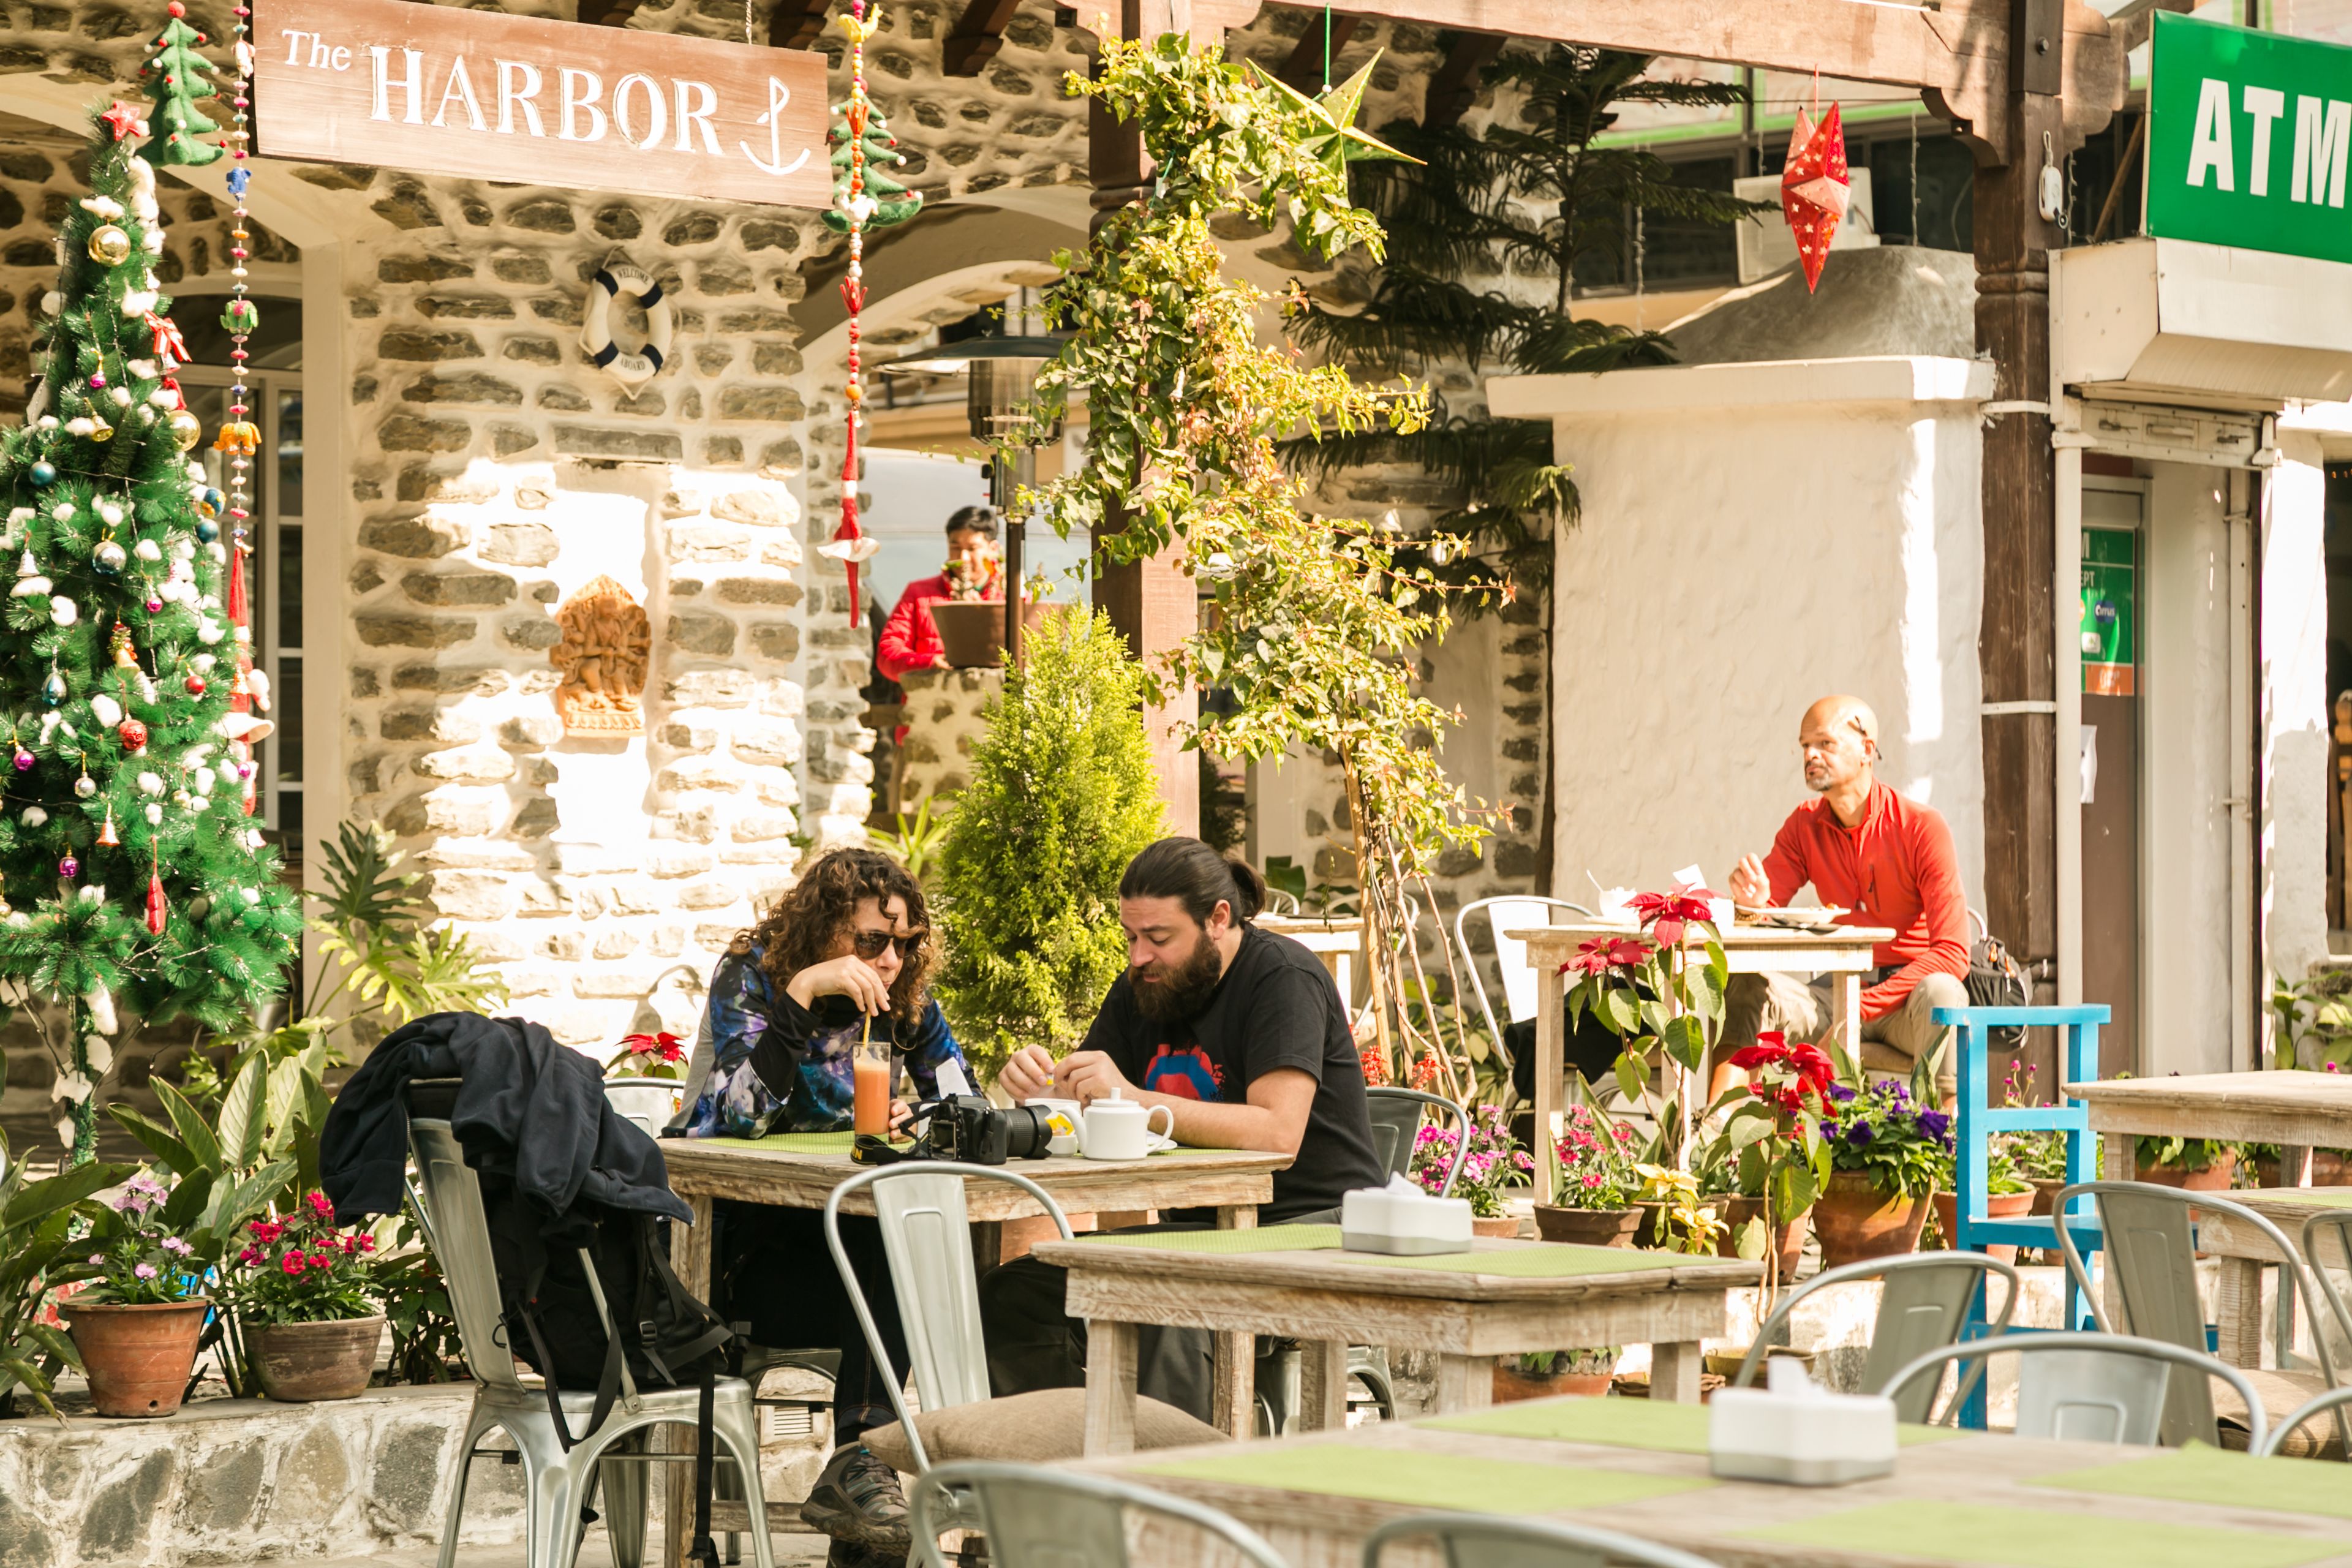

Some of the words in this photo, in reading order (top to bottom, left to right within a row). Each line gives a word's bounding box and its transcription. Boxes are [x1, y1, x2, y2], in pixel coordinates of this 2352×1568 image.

[282, 28, 352, 72] The
[368, 45, 724, 156] HARBOR
[2185, 77, 2352, 209] ATM
[616, 268, 649, 285] WELCOME
[619, 358, 646, 371] ABOARD
[2095, 604, 2116, 617] Cirrus
